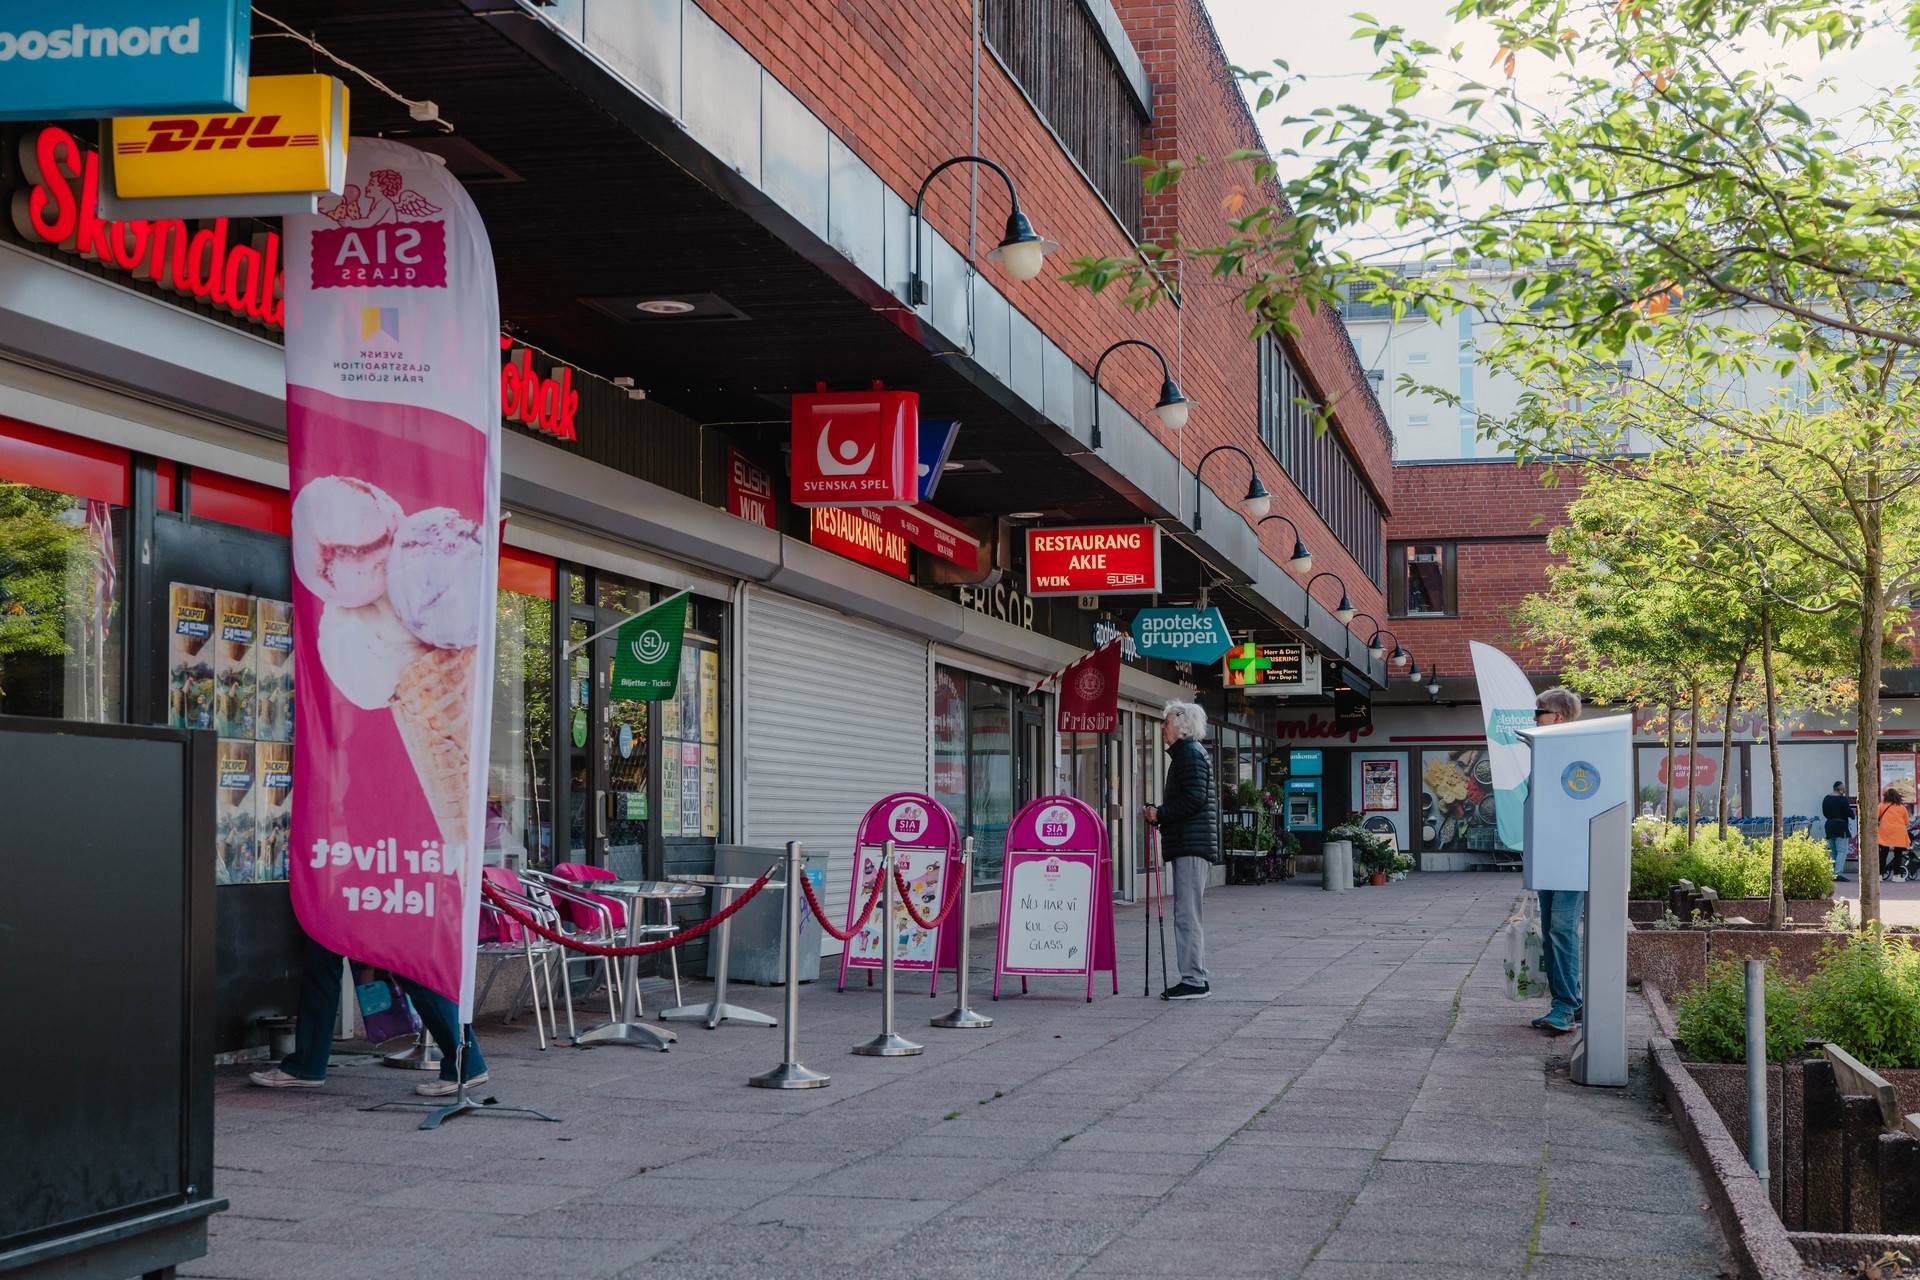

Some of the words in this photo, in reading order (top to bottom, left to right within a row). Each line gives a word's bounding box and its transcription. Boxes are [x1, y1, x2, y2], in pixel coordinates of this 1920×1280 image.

[146, 115, 290, 152] DHL
[500, 336, 579, 441] obak
[734, 460, 771, 497] SUSHI
[803, 480, 857, 491] SVENSKA
[860, 480, 889, 490] SPEL
[739, 495, 766, 527] WOK
[816, 507, 883, 555] RESTAURANG
[885, 531, 907, 564] AKIE
[1034, 533, 1141, 552] RESTAURANG
[1069, 554, 1107, 570] AKIE
[1037, 576, 1070, 586] WOK
[1082, 596, 1094, 607] 87
[177, 607, 204, 620] JACKPOT
[224, 614, 247, 626] JACKPOT
[179, 621, 189, 634] 54
[265, 622, 289, 634] JACKPOT
[1142, 614, 1212, 635] apoteks
[224, 627, 234, 639] 54
[1142, 628, 1218, 648] gruppen
[265, 636, 275, 647] 54
[643, 637, 657, 648] SL
[621, 678, 647, 687] Biljetter
[652, 679, 672, 687] Tickets
[1061, 711, 1113, 731] Frisör
[899, 820, 916, 829] SIA
[1046, 824, 1064, 833] SIA
[1021, 894, 1038, 910] NU
[1029, 938, 1064, 951] GLASS
